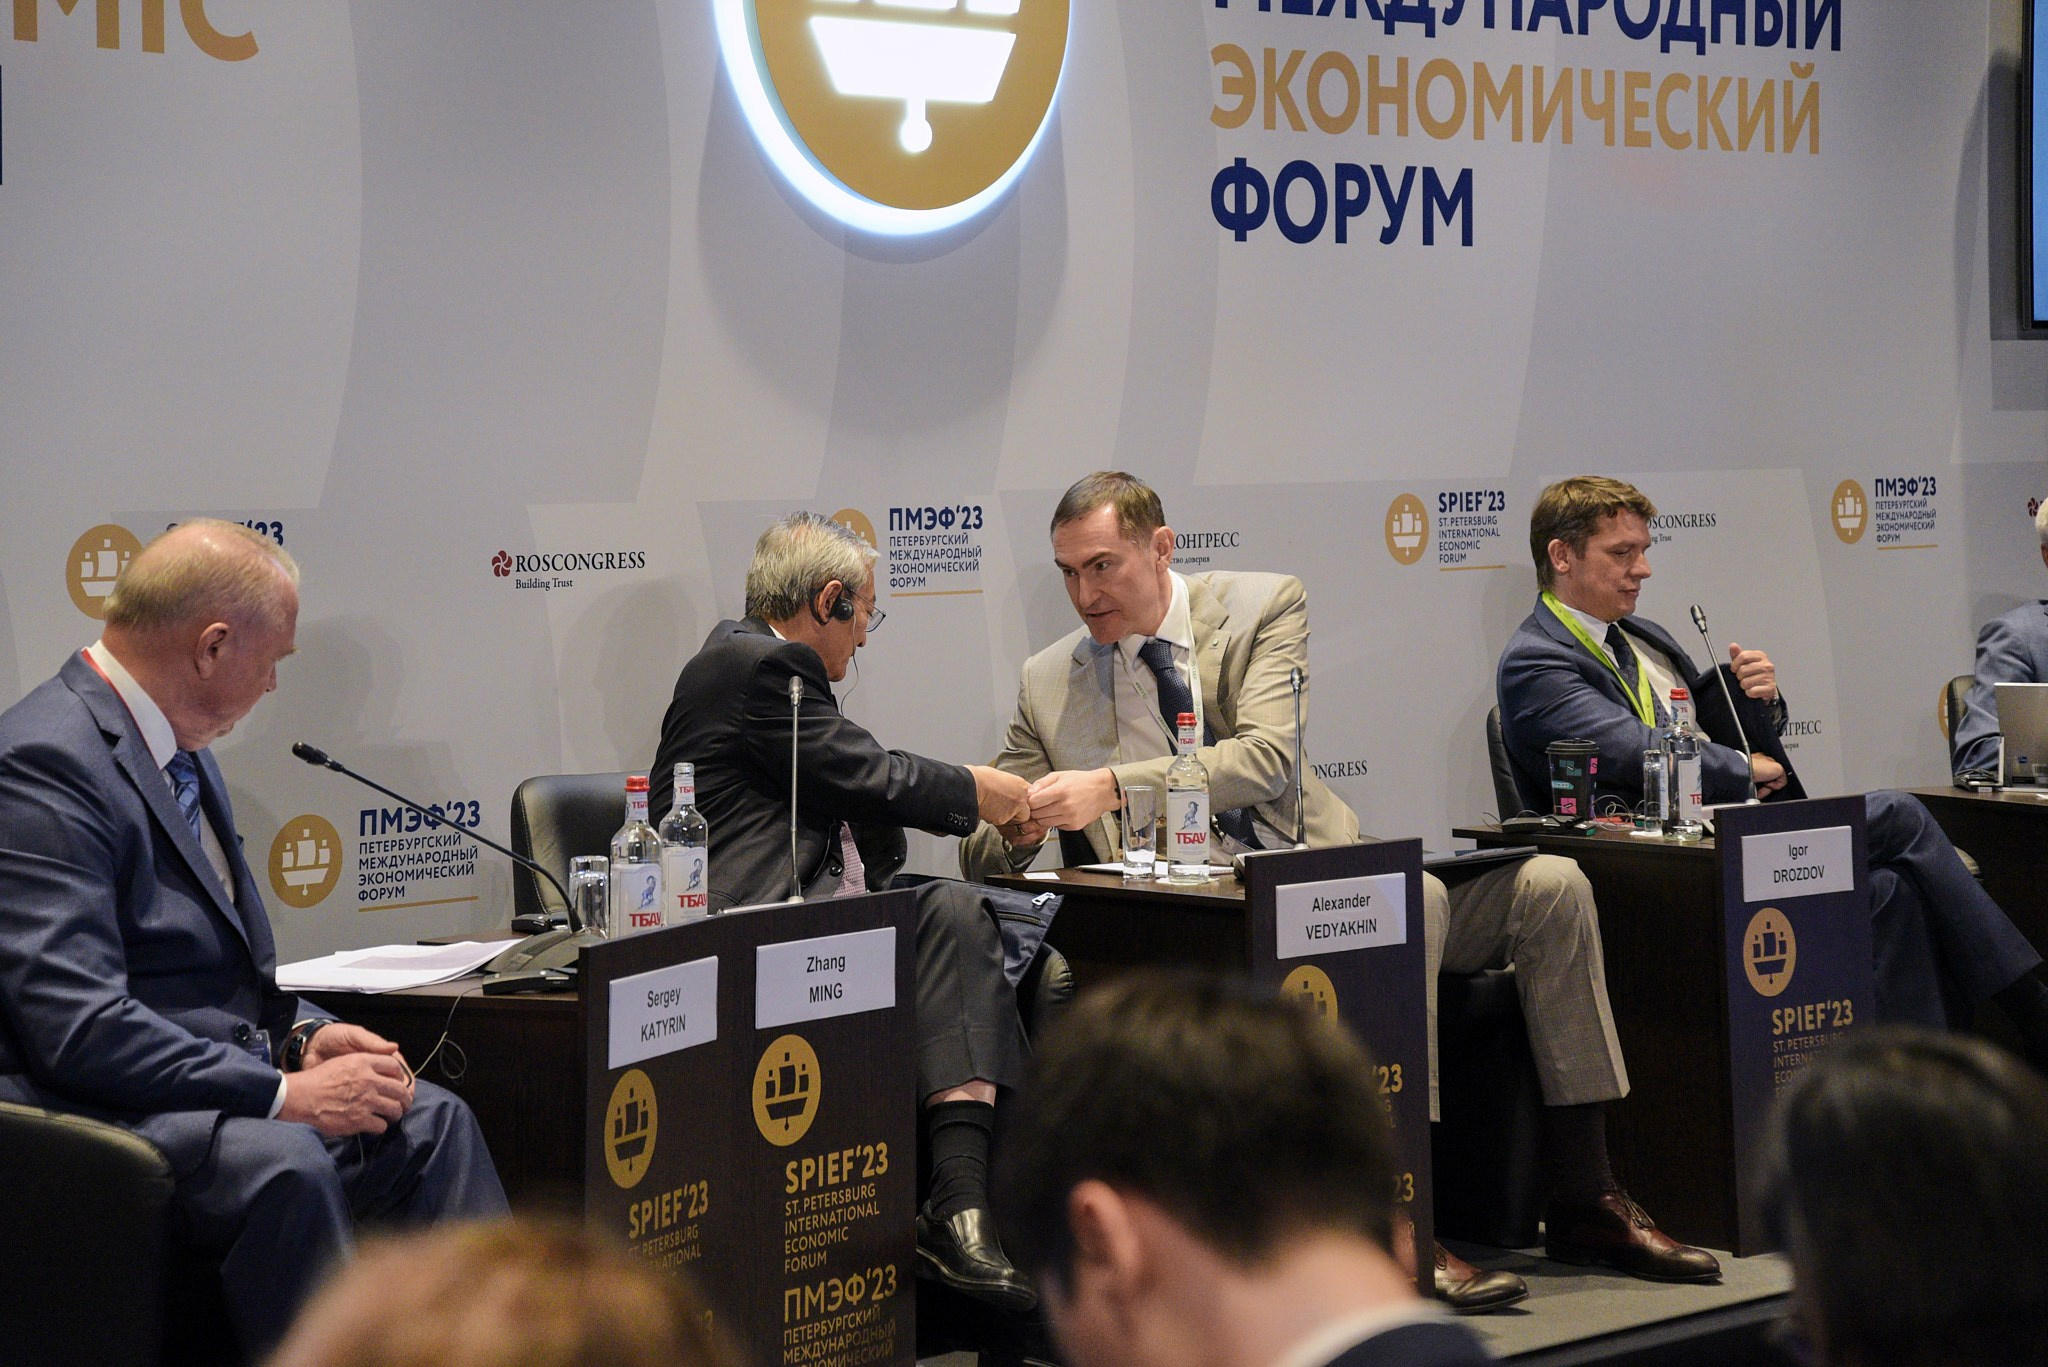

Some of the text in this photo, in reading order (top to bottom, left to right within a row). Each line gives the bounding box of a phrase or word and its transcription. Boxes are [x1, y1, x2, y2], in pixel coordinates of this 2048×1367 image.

[1210, 43, 1820, 155] ЭКОНОМИЧЕСКИЙ
[1211, 157, 1474, 247] ФОРУМ
[1438, 490, 1505, 513] SPIEF'23
[1875, 498, 1928, 510] ПЕТЕРБУРГСКИЙ
[889, 505, 983, 531] ПМЭФ'23
[1439, 515, 1497, 527] ST. PETERSBURG
[1875, 509, 1937, 521] МЕЖДУНАРОДНЫЙ
[1439, 528, 1501, 539] INTERNATIONAL
[1876, 520, 1935, 532] ЭКОНОМИЧЕСКИЙ
[889, 532, 969, 547] ПЕТЕРБУРГСКИЙ
[1174, 532, 1240, 549] ОНГРЕСС
[1439, 540, 1481, 551] ECONOMIC
[1876, 534, 1901, 543] ФОРУМ
[515, 551, 645, 573] ROSCONGRESS
[889, 546, 982, 561] МЕЖДУНАРОДНЫЙ
[1439, 553, 1467, 563] FORUM
[889, 559, 980, 575] ЭКОНОМИЧЕСКИЙ
[515, 578, 573, 591] Building Trust
[889, 576, 926, 589] ФОРУМ
[359, 831, 462, 855] ПЕТЕРБУРГСКИЙ
[1175, 832, 1207, 844] ТБАУ
[358, 845, 478, 870] МЕЖДУНАРОДНЫЙ
[1788, 844, 1808, 860] Igor
[358, 861, 474, 886] ЭКОНОМИЧЕСКИЙ
[1773, 865, 1825, 884] DROZDOV
[358, 886, 405, 902] ФОРУМ
[1312, 893, 1371, 912] Alexander
[1306, 919, 1377, 940] VEDYAKHIN
[806, 956, 846, 973] Zhang
[647, 986, 681, 1008] Sergey
[809, 983, 843, 1003] MING
[1772, 999, 1853, 1036] SPIEF'23
[641, 1014, 686, 1042] KATYRIN
[785, 1142, 889, 1194] SPIEF'23
[629, 1179, 709, 1240] SPIEF'23
[785, 1183, 876, 1217] ST. PETERSBURG
[785, 1201, 880, 1235] INTERNATIONAL
[784, 1226, 849, 1255] ECONOMIC
[784, 1250, 827, 1274] FORUM
[784, 1264, 897, 1323] ПМЭФ'23
